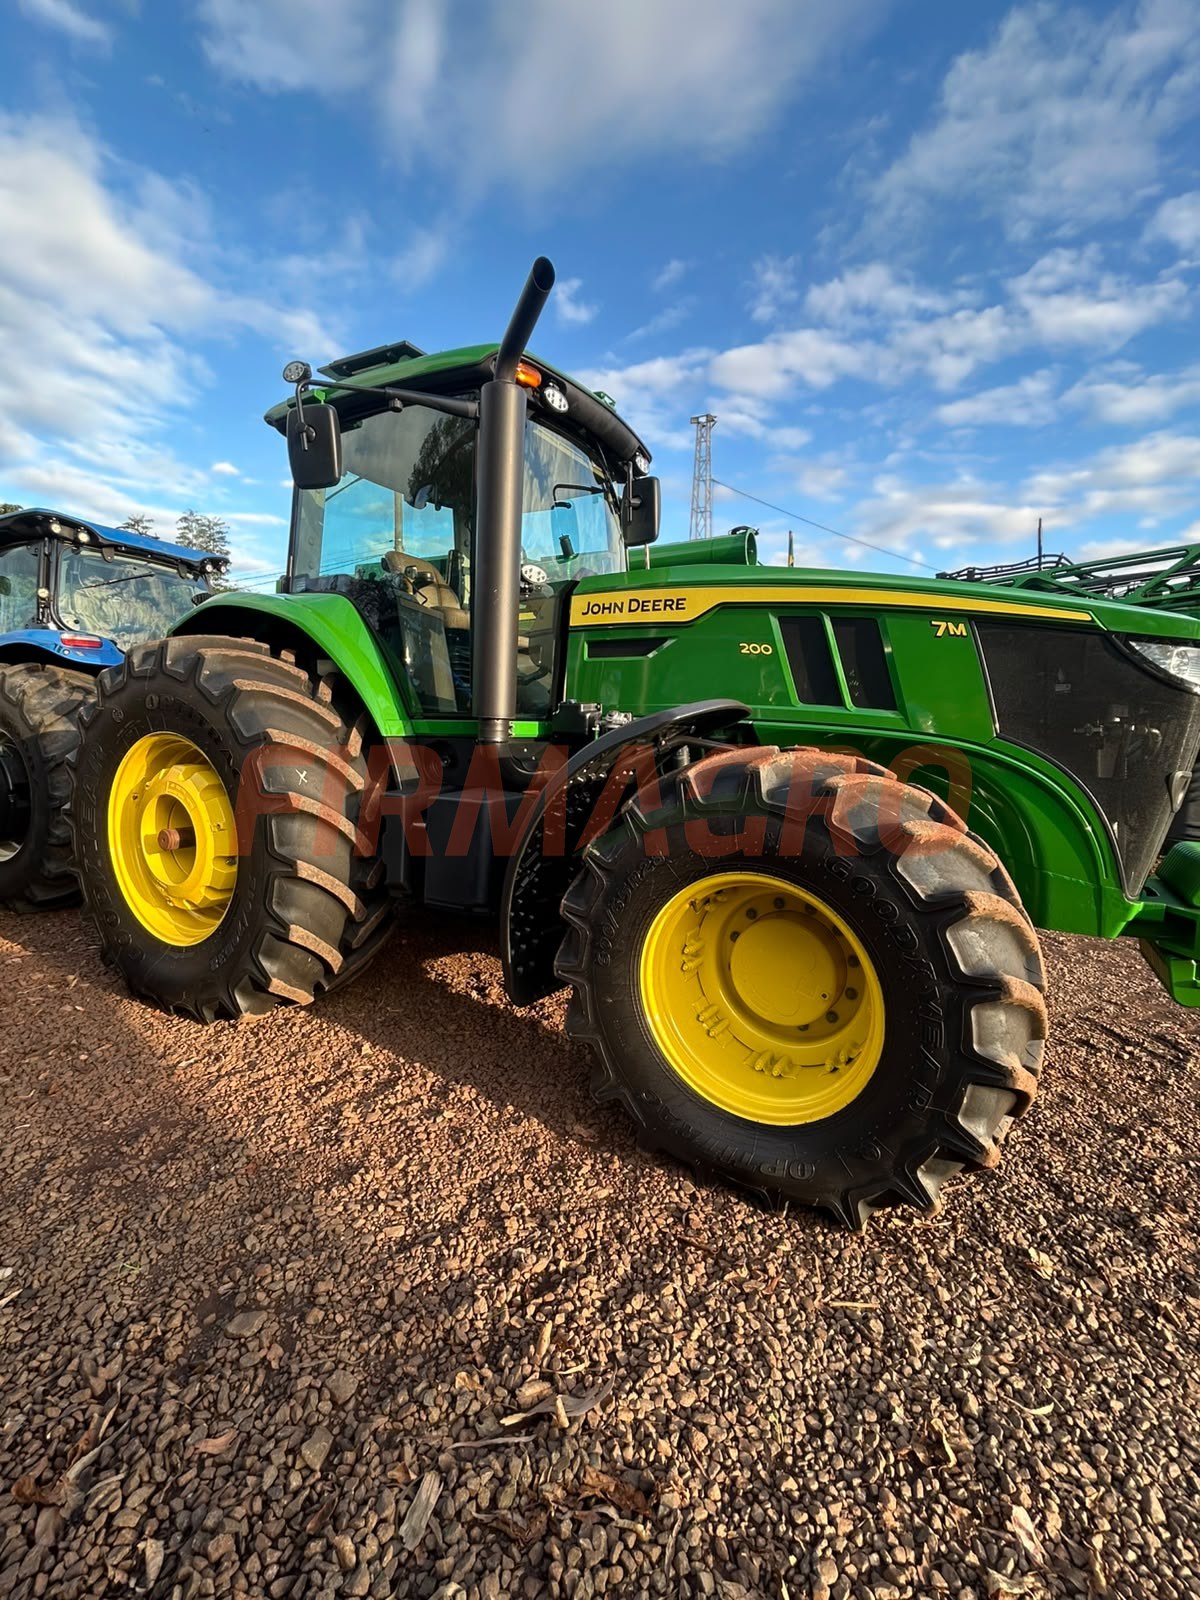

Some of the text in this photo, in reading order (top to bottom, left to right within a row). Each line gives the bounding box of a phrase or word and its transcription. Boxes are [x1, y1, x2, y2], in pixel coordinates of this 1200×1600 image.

[581, 597, 687, 616] JOHN DEERE
[930, 619, 968, 637] 7M
[738, 642, 773, 656] 200
